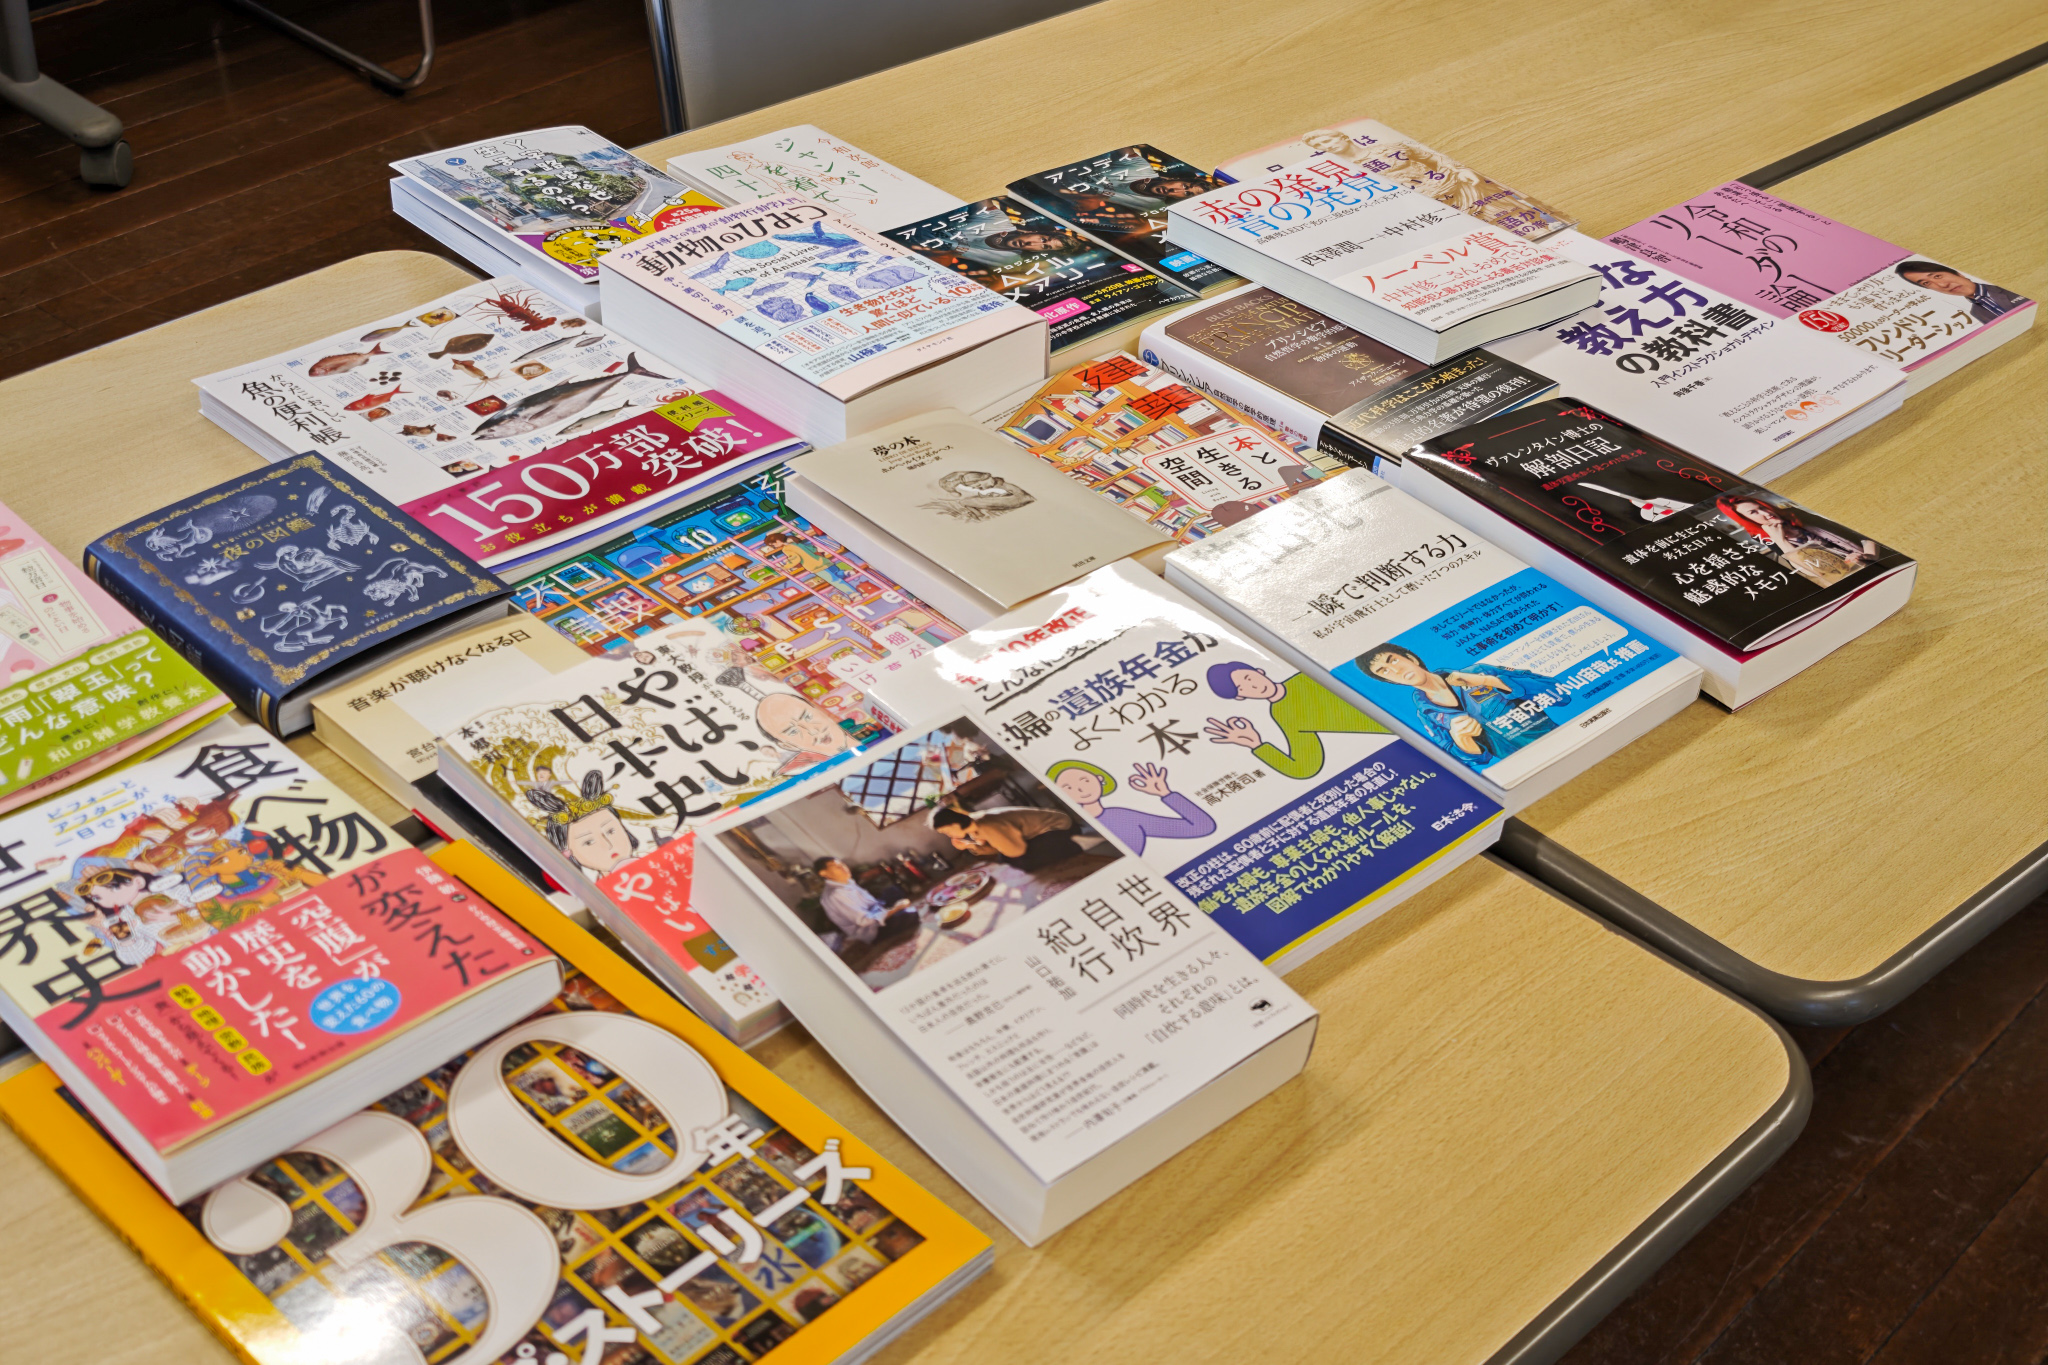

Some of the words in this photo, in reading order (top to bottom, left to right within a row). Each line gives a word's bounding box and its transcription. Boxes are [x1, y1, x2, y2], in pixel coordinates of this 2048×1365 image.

[503, 138, 613, 201] Y字路はなぜ
[775, 137, 878, 194] ジャンパー
[818, 137, 880, 170] 今和次郎
[1044, 152, 1132, 184] アンディ
[1068, 164, 1152, 194] ウィアー
[1199, 159, 1368, 225] 赤の発見
[897, 205, 990, 240] アンディ
[1219, 174, 1399, 237] 青の発見
[1683, 204, 1798, 254] 令和の
[635, 204, 829, 277] 動物のひみつ
[921, 218, 1010, 249] ウィアー
[1649, 214, 1837, 295] リーダー
[733, 267, 755, 278] The
[755, 256, 789, 273] Social
[791, 244, 820, 259] Lives
[759, 270, 773, 279] of
[773, 255, 816, 275] Animals
[993, 252, 1049, 274] プロジェクト
[1004, 262, 1106, 302] メアリー
[1362, 231, 1527, 294] ノーベル賞、
[1381, 243, 1546, 303] 中村修二さんおめでとう。
[839, 285, 924, 317] 生き物たちは、
[860, 296, 956, 334] 人間に似ている。
[868, 295, 922, 318] 驚くほど
[1206, 306, 1239, 323] BLUE
[1240, 294, 1274, 312] BACKS
[1556, 280, 1709, 356] 教え方
[1755, 284, 1822, 313] 論
[1836, 294, 1932, 343] 50000人のリーダーが学んだ
[1265, 320, 1326, 349] プリンシピア
[1265, 322, 1348, 361] 自然哲学の数学的原
[1616, 303, 1758, 375] の教科書
[1650, 320, 1775, 390] 入門インストラクショナルデザイン
[1855, 309, 1936, 351] フレンドリー
[1879, 309, 1974, 363] リーダーシップ
[242, 379, 351, 446] 魚の便利帳
[666, 400, 705, 416] 便利帳
[676, 404, 716, 423] シリーズ
[872, 435, 921, 457] 夢の本
[1195, 445, 1263, 492] 生きる
[1228, 433, 1278, 467] 本と
[1485, 422, 1604, 468] ヴァレンタイン博士の
[1519, 436, 1624, 480] 解剖日記
[429, 425, 671, 543] 150万部
[1158, 457, 1214, 492] 空間
[222, 517, 317, 562] 夜の図鑑
[480, 483, 652, 554] お役立ちが満載
[681, 527, 718, 552] 10
[1621, 513, 1728, 566] 遺体を前に生について
[1662, 533, 1723, 561] 考えた日々。
[1674, 531, 1776, 586] 心を揺さぶる
[1291, 532, 1470, 622] 一瞬で判断する力
[1312, 549, 1483, 640] 私が宇宙飛行士として磨いた7つのスキル
[1682, 563, 1765, 607] 魅惑的な
[1744, 557, 1823, 601] メモワール
[1429, 583, 1523, 635] 決してエリートではなかったが、
[1442, 582, 1549, 642] 知力・精神力・体力すべてが問われる
[1454, 599, 1541, 649] JAXA、NASAで認められた
[347, 629, 532, 712] 音楽が聴けなくなる日
[656, 644, 752, 722] 東大教授がおしえる
[1000, 630, 1221, 751] 婦の遺族年金が
[1486, 688, 1563, 736] 『宇宙兄弟』
[1614, 639, 1650, 662] 推薦
[47, 685, 207, 764] 和の雑学教養本
[617, 665, 761, 787] やばい
[1067, 672, 1199, 752] よくわかる
[405, 736, 442, 760] 宮台
[458, 726, 518, 778] 本郷和人
[548, 694, 724, 834] 日本史
[1137, 718, 1201, 761] 本
[47, 778, 138, 821] ビフォーと
[52, 785, 151, 836] アフターが
[175, 742, 392, 876] 食べ物
[1201, 774, 1256, 807] 高木隆司
[54, 793, 179, 847] 一目でわかる
[1175, 760, 1387, 891] 改正の柱は、60歳前に配偶者と死別した場合の
[1430, 801, 1478, 833] 日本法令
[348, 861, 510, 987] が変えた
[1080, 897, 1161, 963] 自炊
[1116, 873, 1193, 937] 世界
[235, 921, 323, 989] 歴史を
[278, 893, 391, 981] 「空腹」が
[1037, 917, 1116, 985] 紀行
[317, 983, 357, 1012] 世界を
[1113, 949, 1230, 1021] 同時代を生きる人々、
[1157, 974, 1218, 1016] それぞれの
[350, 995, 391, 1030] 食べ物
[754, 1247, 802, 1291] 水
